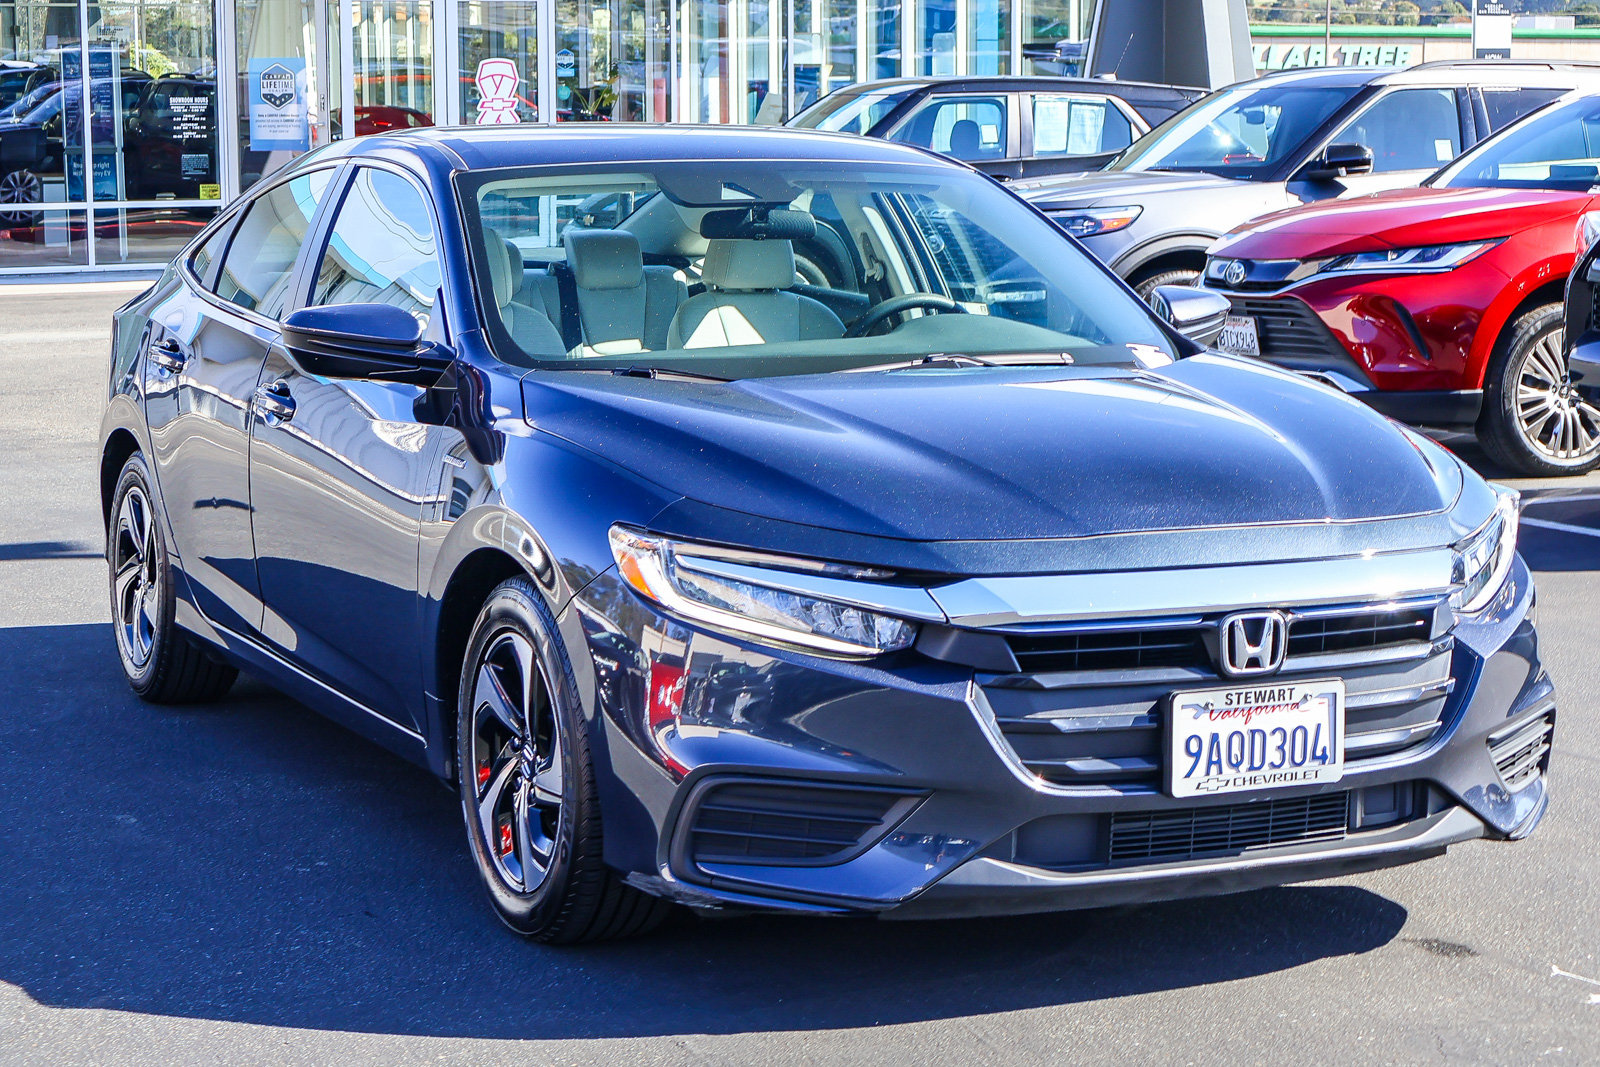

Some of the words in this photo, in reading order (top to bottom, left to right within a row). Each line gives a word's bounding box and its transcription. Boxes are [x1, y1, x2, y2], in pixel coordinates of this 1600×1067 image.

[1340, 45, 1413, 67] TREE
[262, 81, 293, 89] LIFETIME
[170, 96, 193, 104] SHOWROOM
[194, 96, 208, 104] HOURS
[1225, 687, 1295, 706] STEWART
[1184, 723, 1330, 779] 9AQD304
[1233, 769, 1322, 787] CHEVROLET
